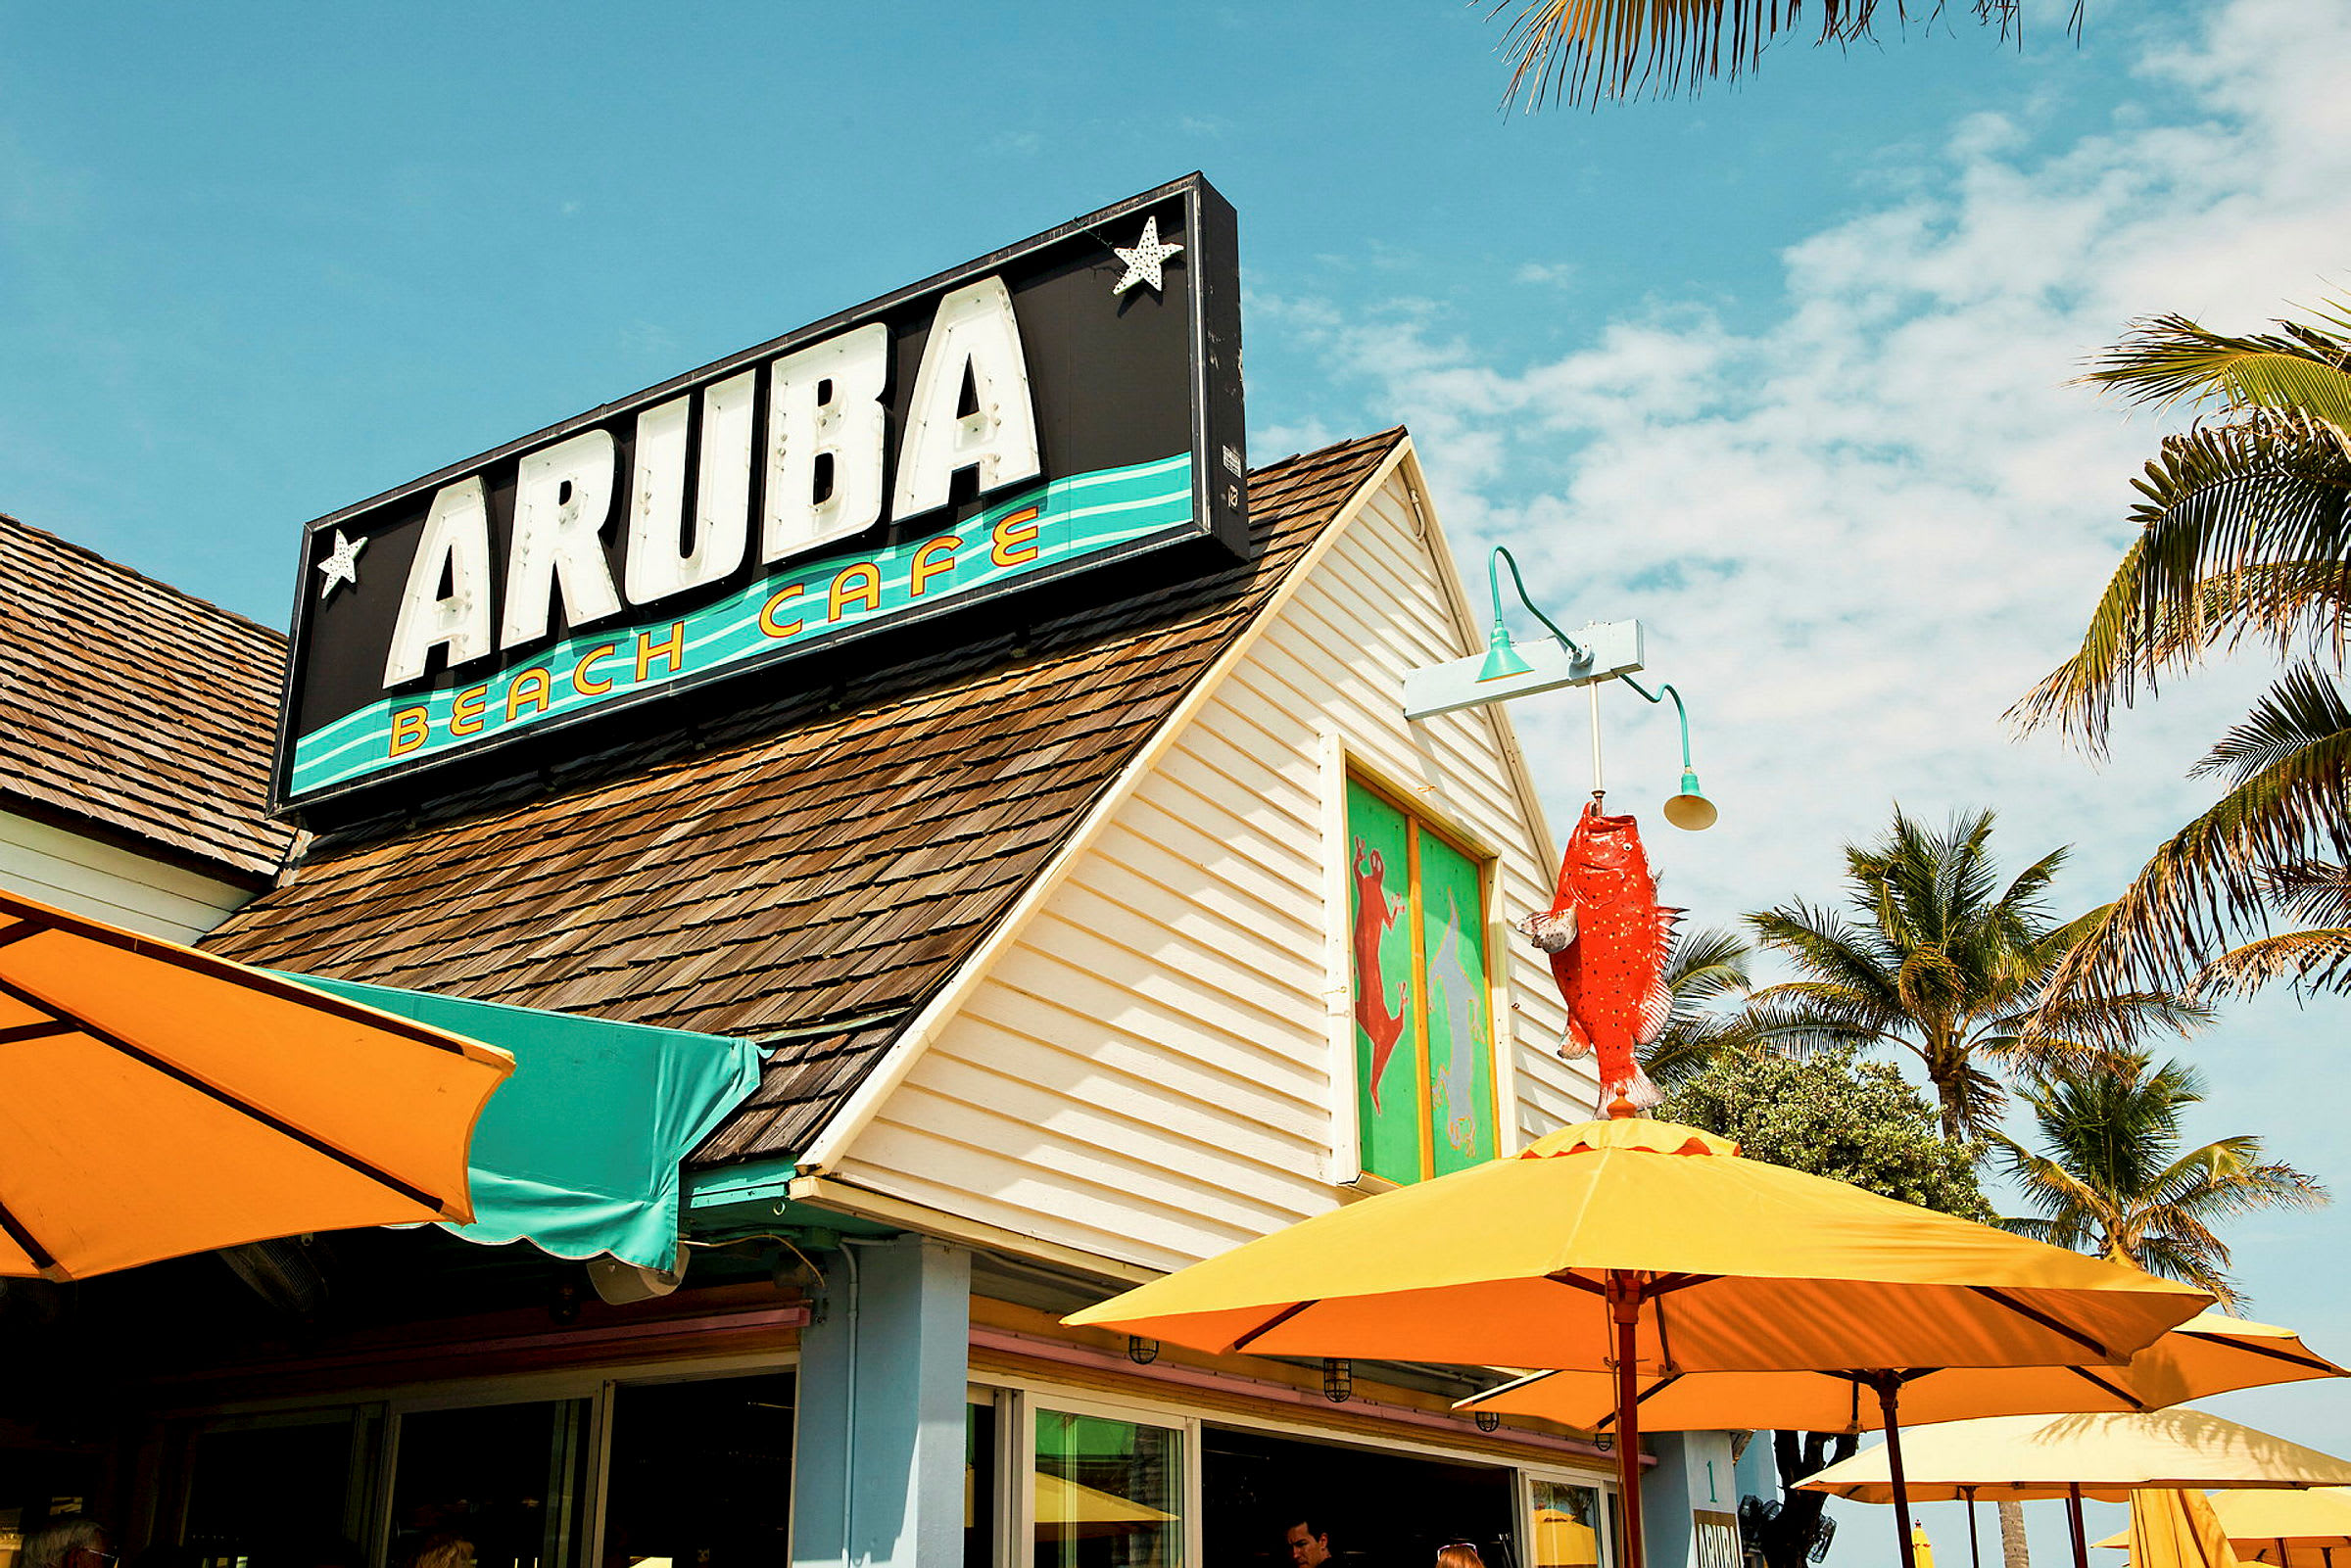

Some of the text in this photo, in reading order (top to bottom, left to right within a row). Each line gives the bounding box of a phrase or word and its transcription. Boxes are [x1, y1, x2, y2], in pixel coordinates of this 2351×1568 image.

[382, 274, 1041, 689] ARUBA
[389, 505, 1039, 758] BEACH CAFE
